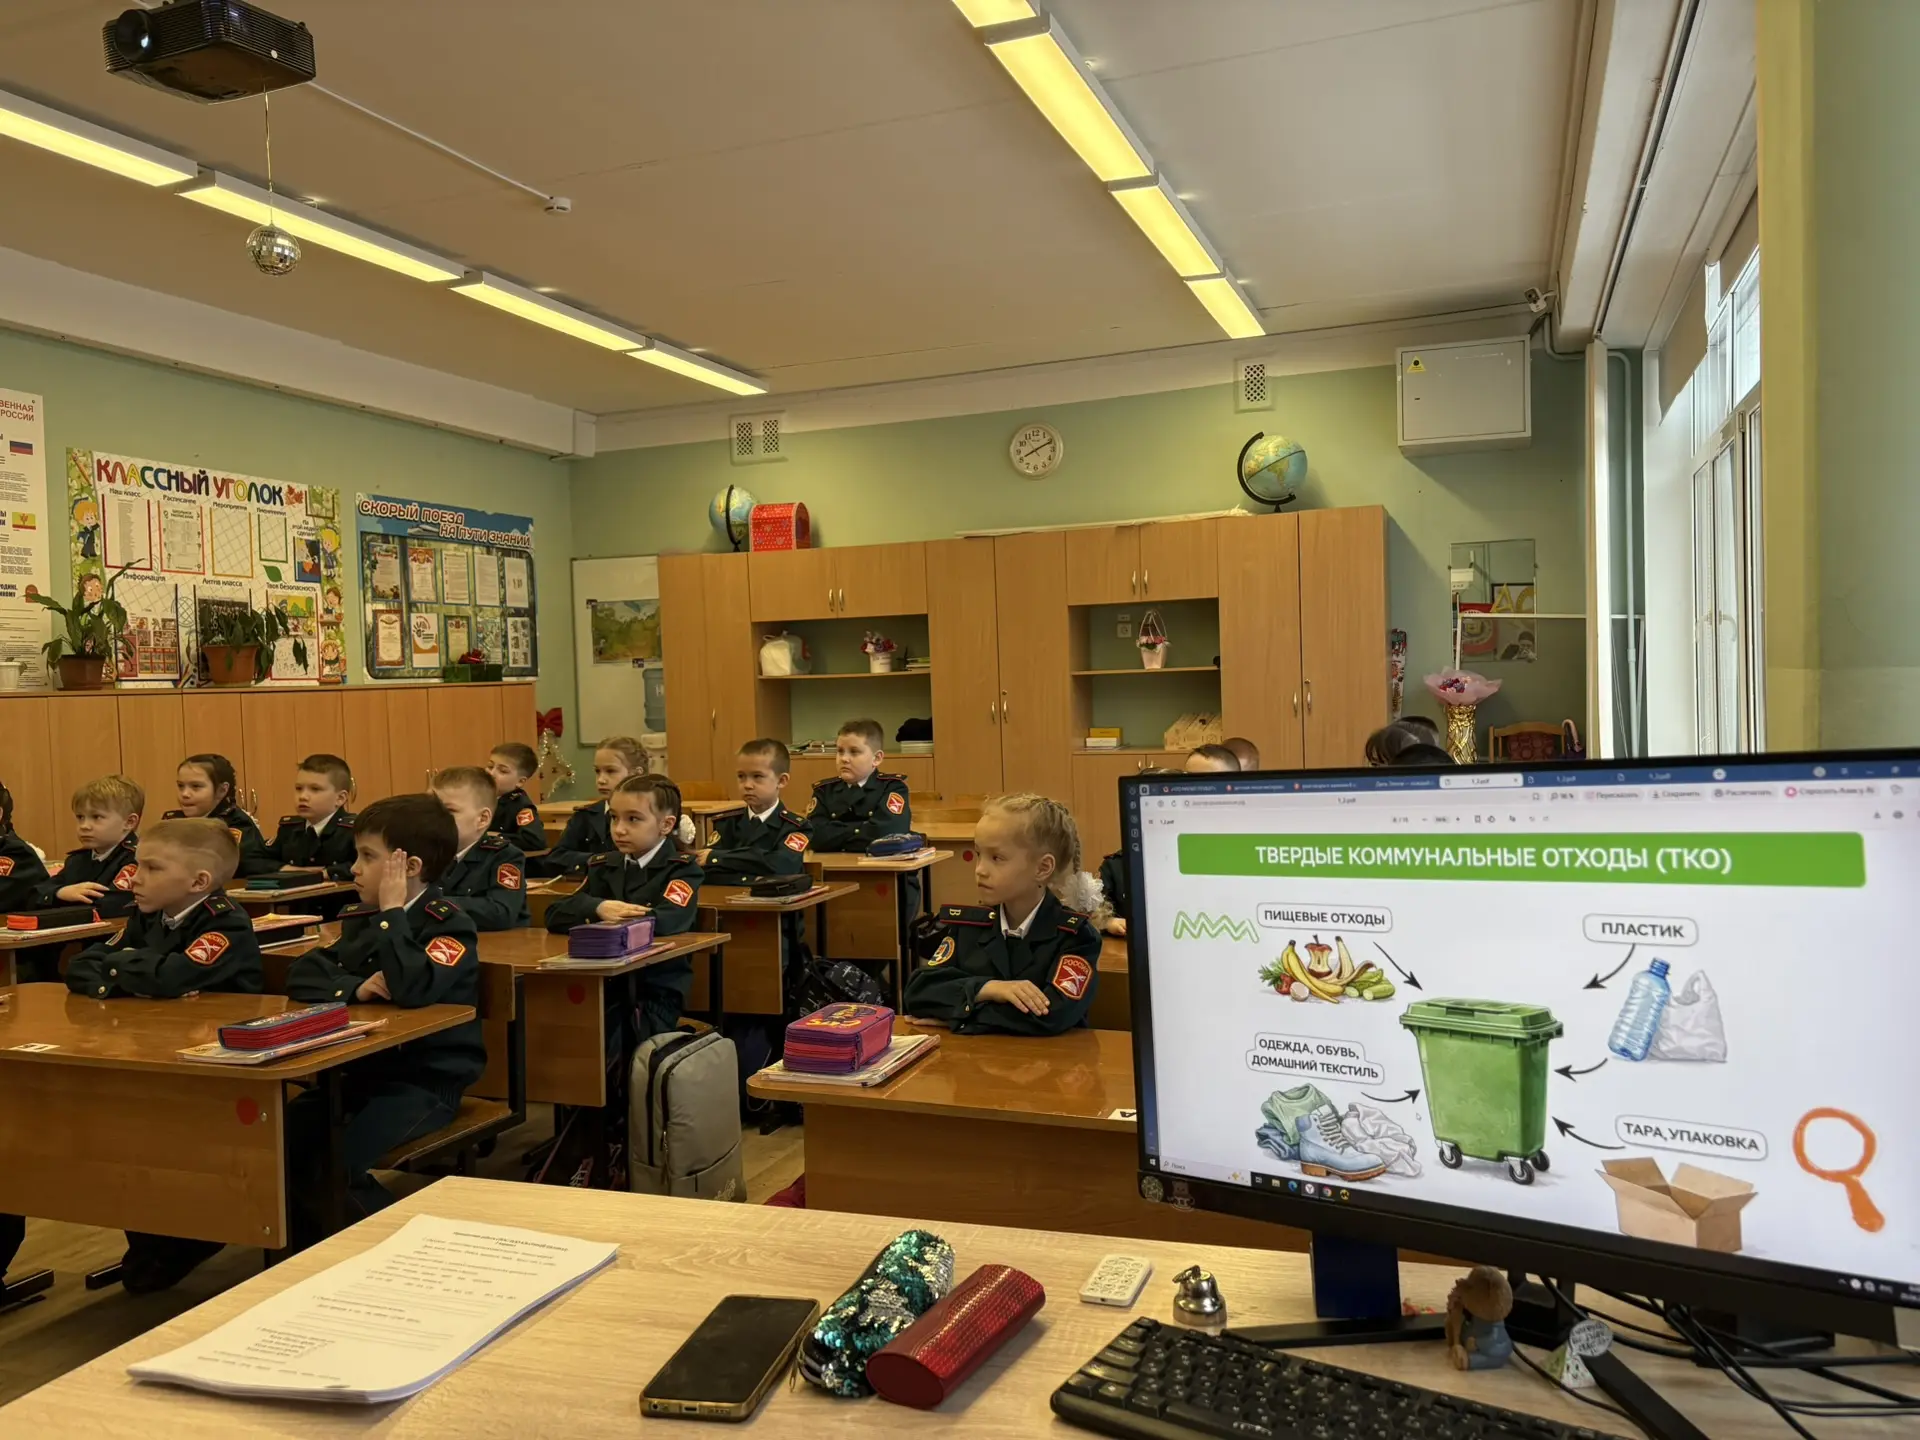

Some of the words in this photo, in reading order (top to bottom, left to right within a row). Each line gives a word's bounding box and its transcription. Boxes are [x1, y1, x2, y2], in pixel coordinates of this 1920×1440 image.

[1, 409, 34, 421] РОССИИ
[96, 458, 210, 497] КЛАССНЫЙ
[212, 475, 285, 506] УГОЛОК
[109, 488, 123, 496] Наш
[124, 490, 141, 498] класс
[162, 495, 197, 504] Расписание
[359, 500, 419, 520] СКОРЫЙ
[421, 507, 465, 525] ПОЕЗД
[440, 524, 457, 538] НА
[458, 526, 488, 542] ПУТИ
[488, 530, 532, 548] ЗНАНИЙ
[222, 580, 243, 588] класса
[279, 583, 317, 592] безопасность
[1255, 846, 1344, 867] ТВЕРДЫЕ
[1348, 847, 1537, 868] КОММУНАЛЬНЫЕ
[1542, 848, 1649, 872] ОТХОДЫ
[1656, 847, 1732, 875] (ТКО)
[1264, 910, 1328, 923] ПИЩЕВЫЕ
[1331, 912, 1385, 926] ОТХОДЫ
[1601, 922, 1685, 938] ПЛАСТИК
[1259, 1038, 1314, 1055] ОДЕЖДА,
[1316, 1044, 1360, 1060] ОБУВЬ,
[1252, 1054, 1318, 1071] ДОМАШНИЙ
[1319, 1062, 1379, 1078] ТЕКСТИЛЬ
